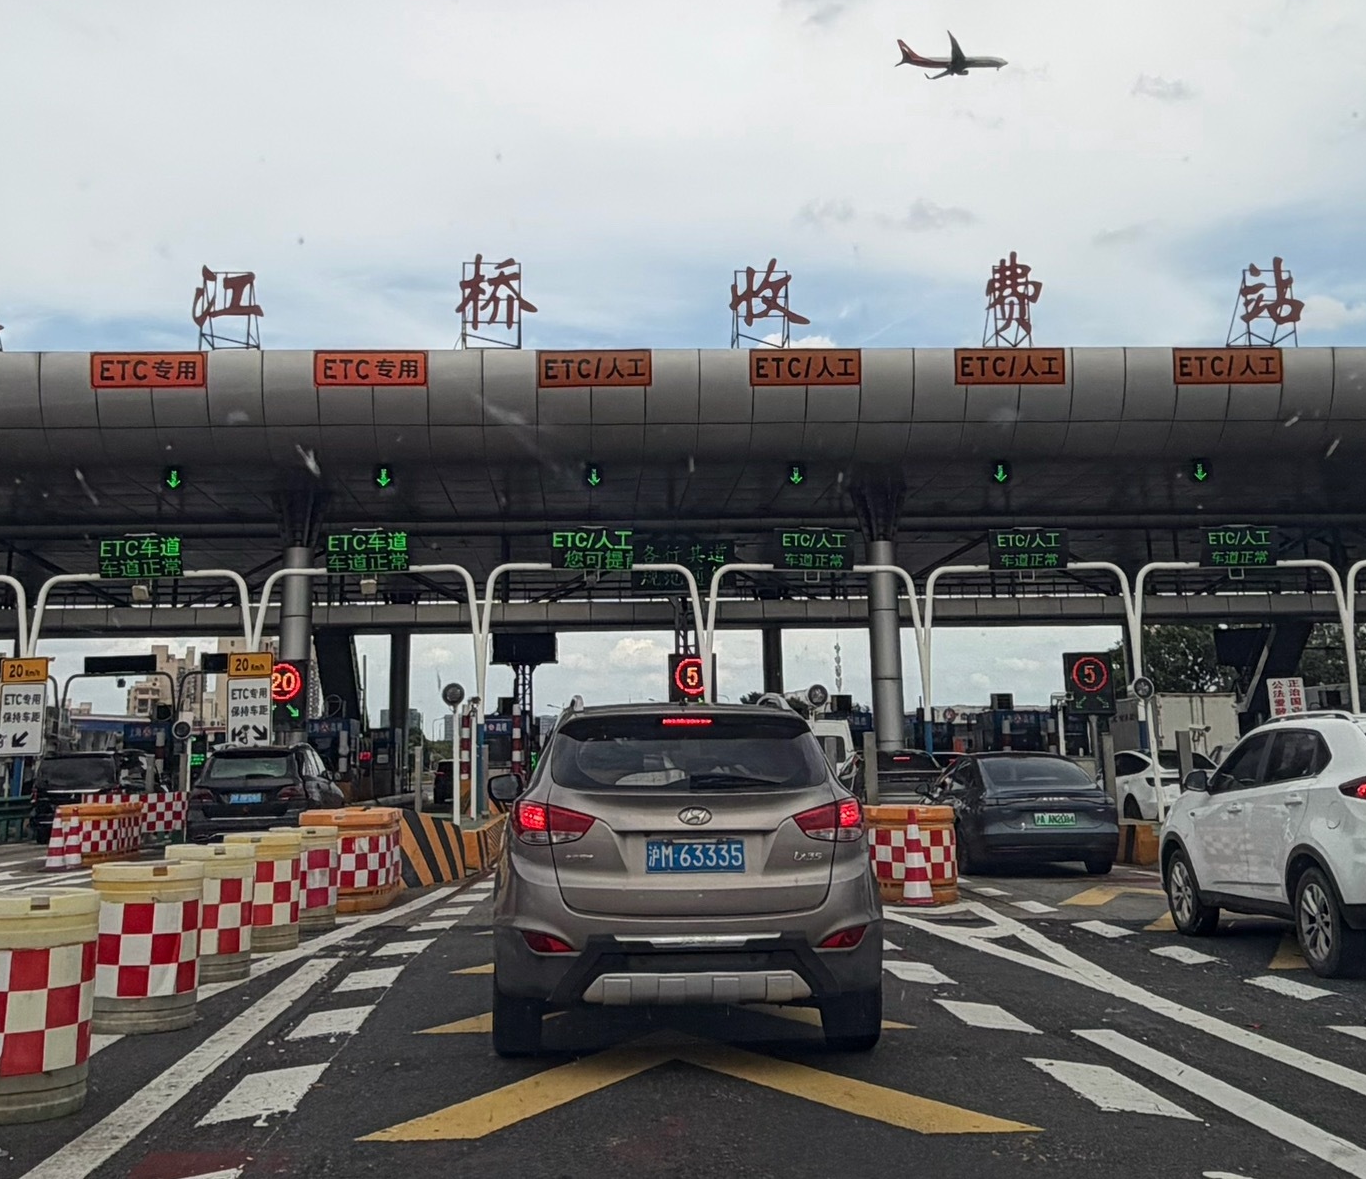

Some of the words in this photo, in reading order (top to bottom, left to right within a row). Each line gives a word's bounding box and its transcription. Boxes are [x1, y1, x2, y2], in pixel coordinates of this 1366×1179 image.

[99, 356, 198, 382] ETC专用
[323, 356, 419, 381] ETC专用
[544, 356, 647, 381] ETC/人工
[755, 355, 856, 380] ETC/人工
[960, 354, 1061, 378] ETC/人工
[1179, 354, 1278, 378] ETC/人工
[100, 537, 181, 558] ETC车道
[327, 532, 408, 552] ETC车道
[552, 531, 633, 549] ETC/人工
[782, 533, 846, 549] ETC/人工
[997, 533, 1061, 548] ETC/人工
[1208, 531, 1272, 546] ETC/人工
[327, 553, 409, 571] 车道正常
[784, 553, 844, 568] 车道正常
[1000, 554, 1059, 567] 车道正常
[1212, 551, 1269, 565] 车道正常
[100, 559, 182, 577] 车道正常
[9, 664, 23, 678] 20
[235, 658, 249, 671] 20
[271, 672, 296, 691] 20
[687, 667, 699, 686] 5
[1084, 665, 1096, 684] 5
[4, 694, 41, 705] ETC专用
[231, 688, 267, 700] ETC专用
[3, 712, 41, 723] 保持车距
[231, 705, 269, 717] 保持车距
